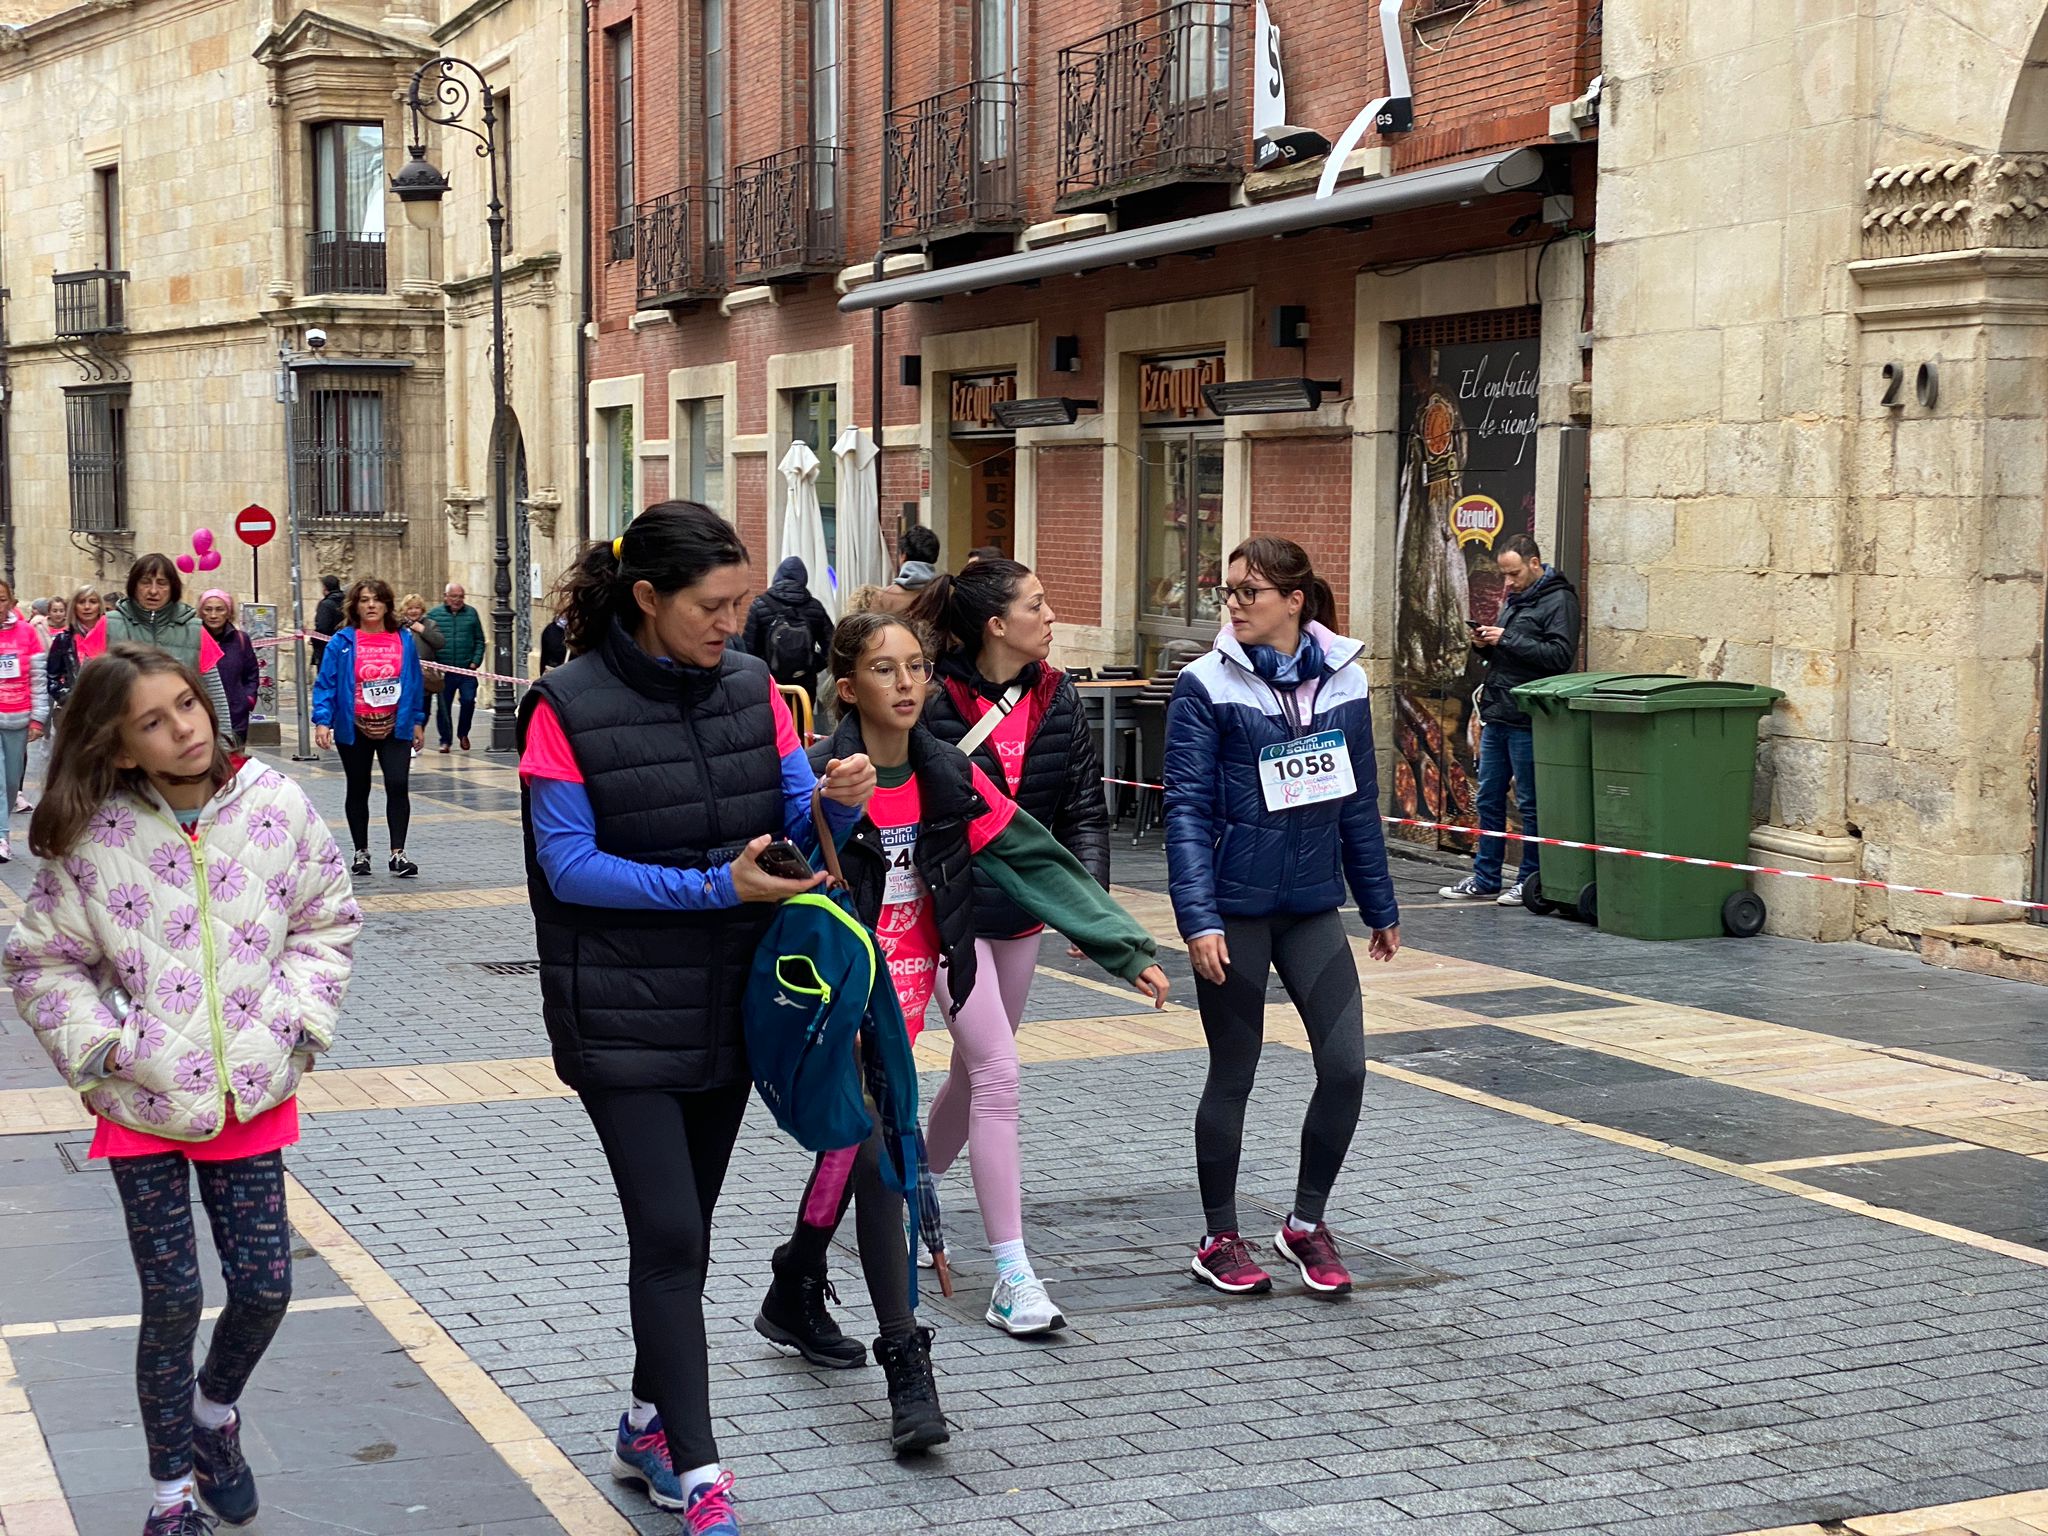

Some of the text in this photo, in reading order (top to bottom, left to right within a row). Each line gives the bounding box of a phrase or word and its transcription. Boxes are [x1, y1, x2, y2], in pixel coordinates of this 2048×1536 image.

[1140, 355, 1223, 418] Ezequiel
[1460, 351, 1540, 399] El embutid
[1881, 361, 1939, 410] 20
[953, 376, 1015, 428] Ezequiel
[1478, 394, 1498, 439] de
[1457, 506, 1496, 532] Ezequiel
[369, 686, 395, 697] 1349
[1274, 753, 1335, 780] 1058
[881, 833, 918, 845] olitiu
